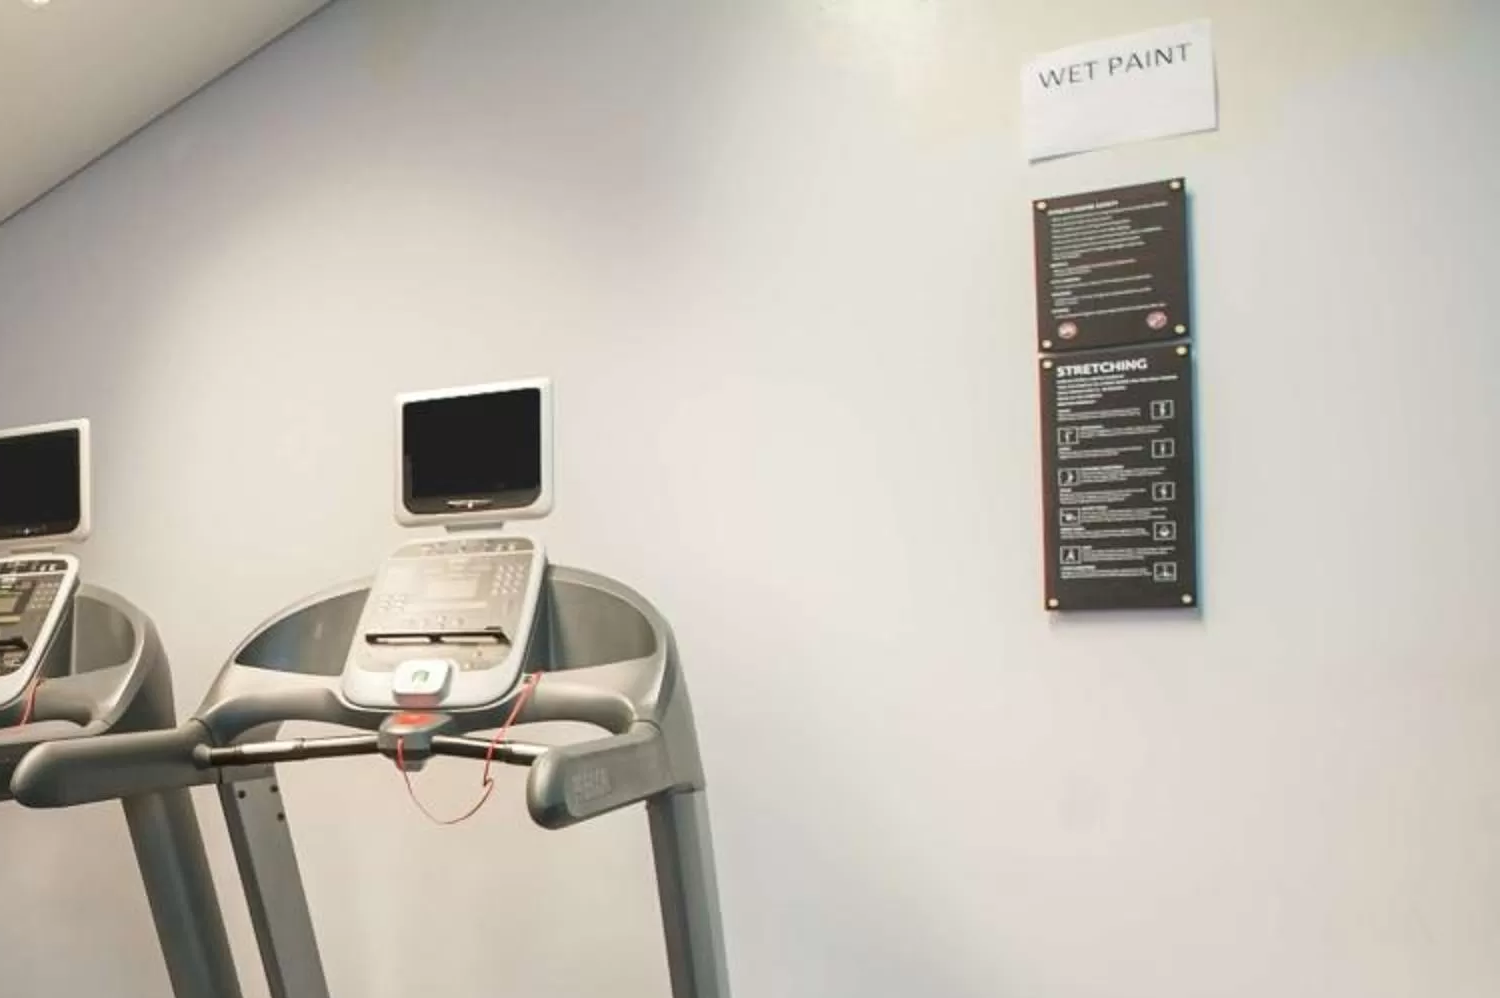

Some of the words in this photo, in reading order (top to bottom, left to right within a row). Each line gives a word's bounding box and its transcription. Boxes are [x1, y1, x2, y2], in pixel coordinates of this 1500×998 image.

[1038, 60, 1099, 90] WET
[1107, 41, 1193, 77] PAINT
[1056, 357, 1148, 378] STRETCHING
